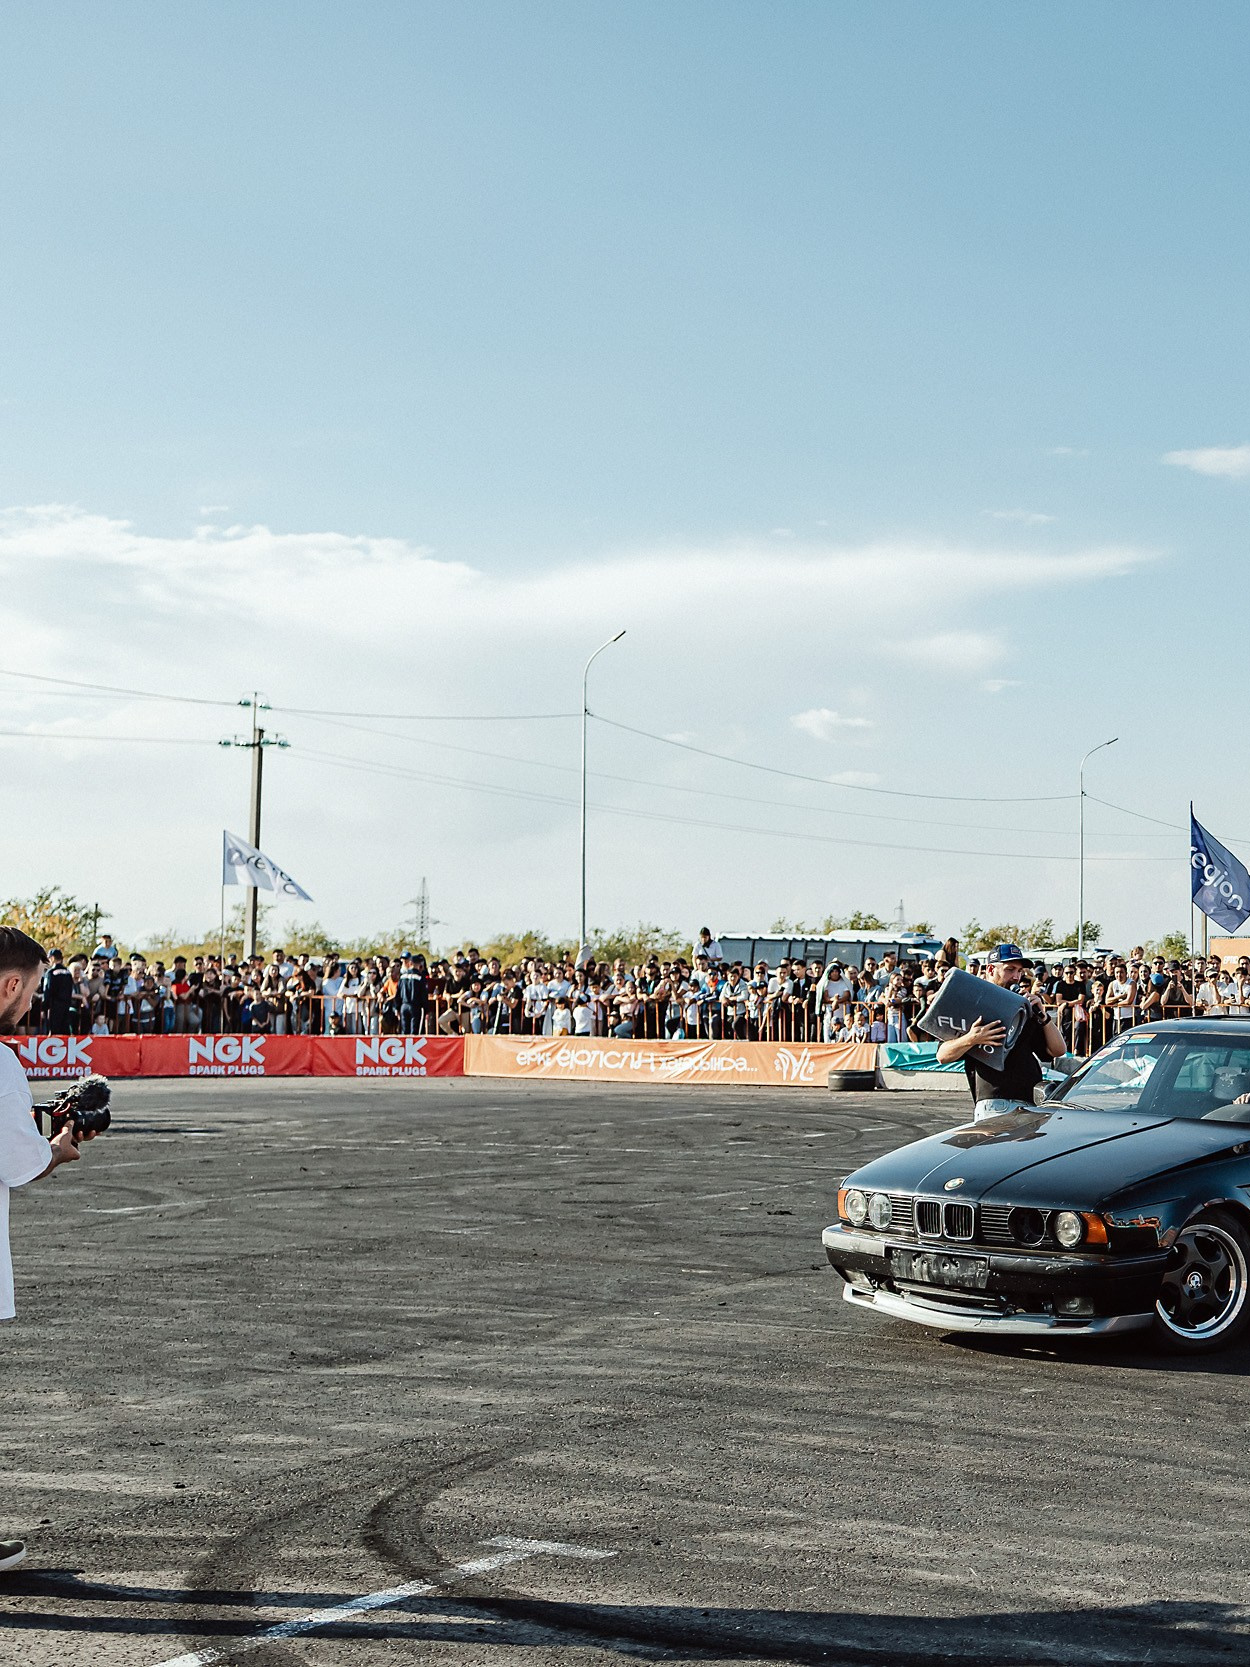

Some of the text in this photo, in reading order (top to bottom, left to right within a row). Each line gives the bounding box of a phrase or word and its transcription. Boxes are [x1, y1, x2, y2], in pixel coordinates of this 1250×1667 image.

[937, 1015, 967, 1032] FLI
[20, 1037, 93, 1065] NGK
[189, 1036, 266, 1064] NGK
[356, 1037, 428, 1065] NGK
[24, 1066, 92, 1076] ARK PLUGS
[189, 1065, 265, 1075] SPARK PLUGS
[356, 1066, 427, 1076] SPARK PLUGS
